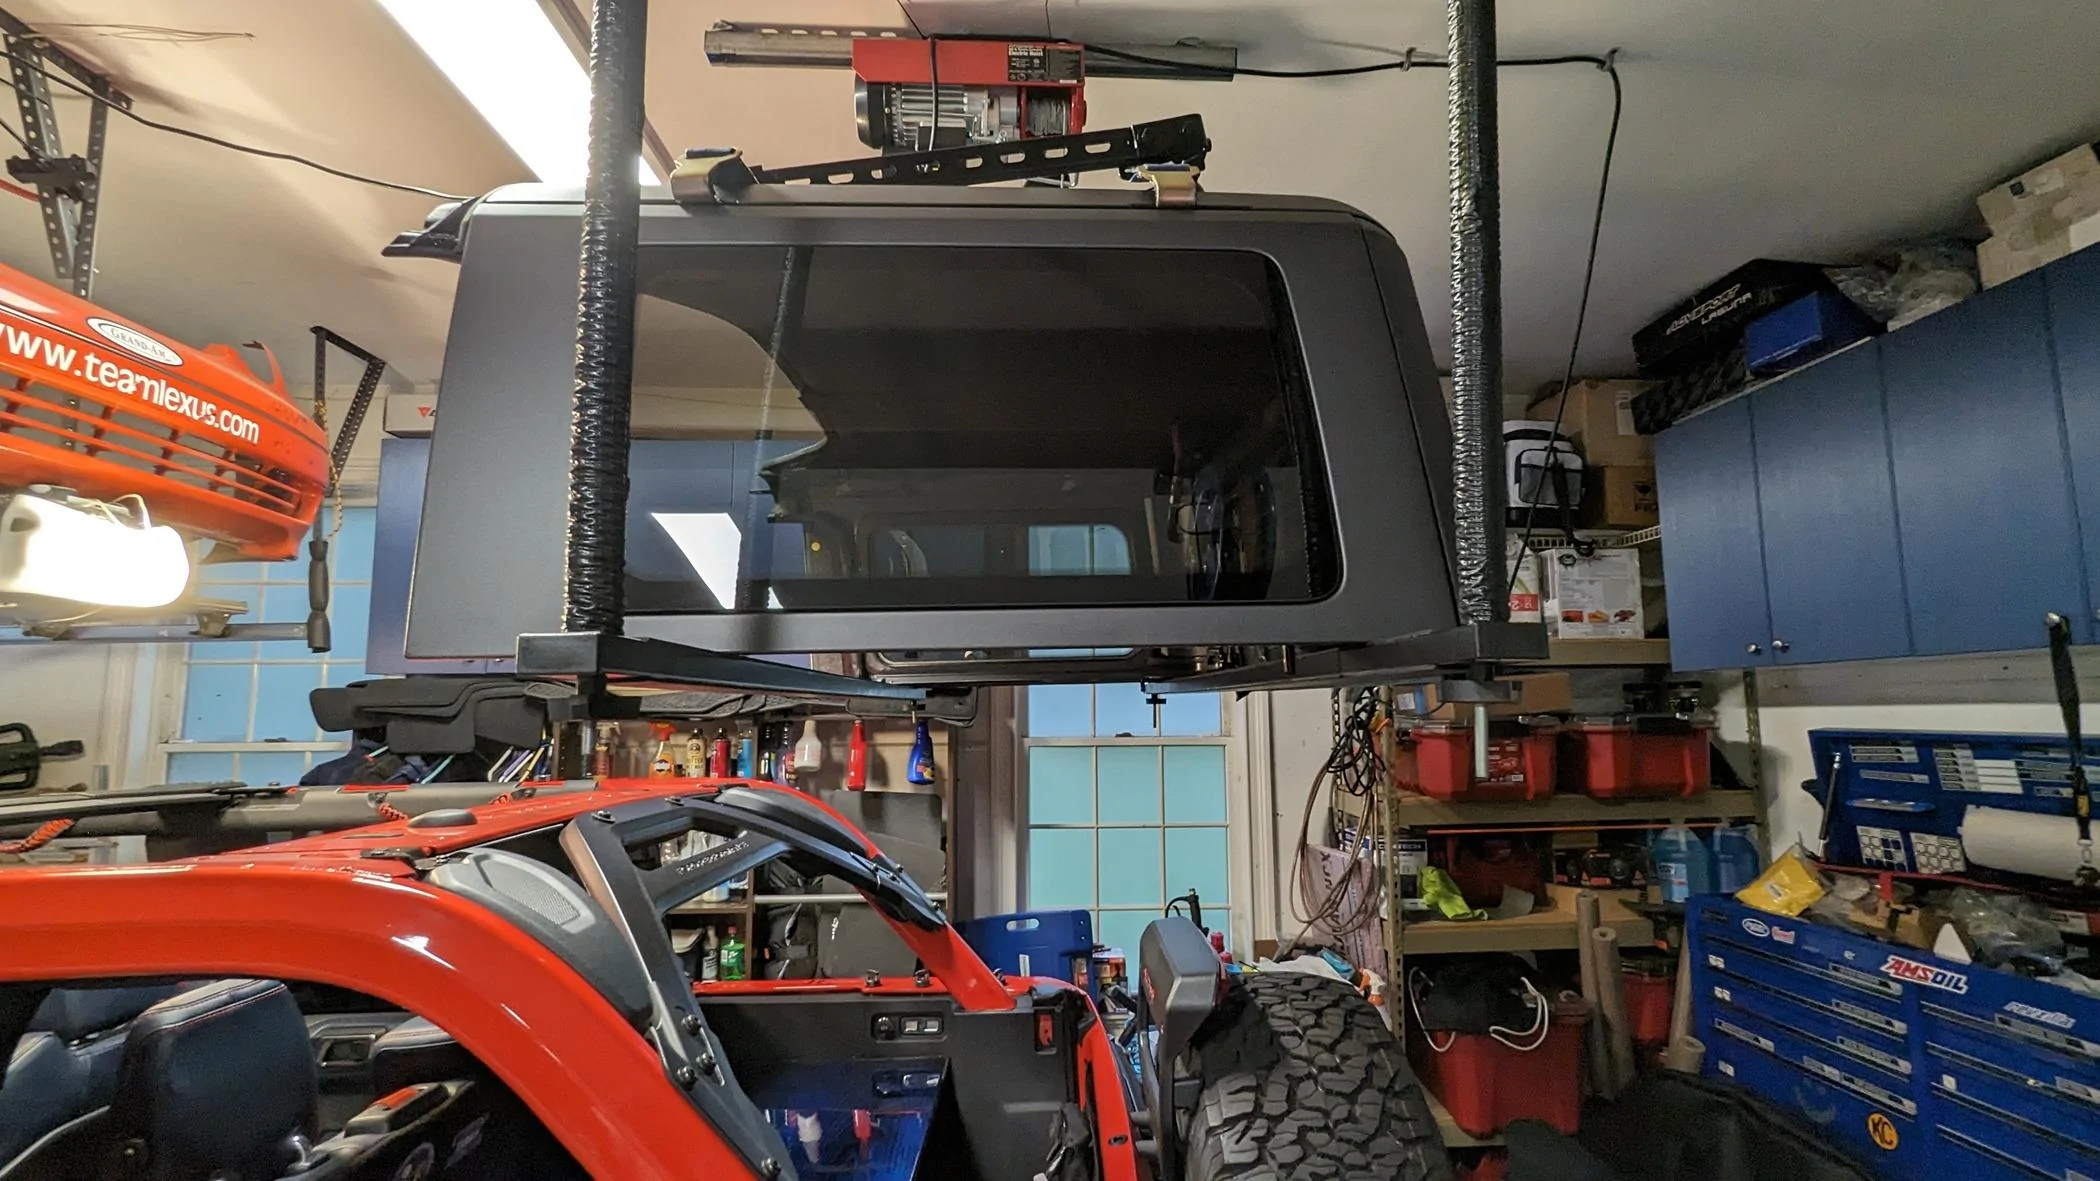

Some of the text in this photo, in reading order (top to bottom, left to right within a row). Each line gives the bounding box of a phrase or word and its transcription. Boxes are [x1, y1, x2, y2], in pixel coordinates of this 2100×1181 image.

[0, 323, 260, 444] ww.teamlexus.com
[1885, 958, 1964, 991] AMSOIL
[1871, 1117, 1894, 1146] KC
